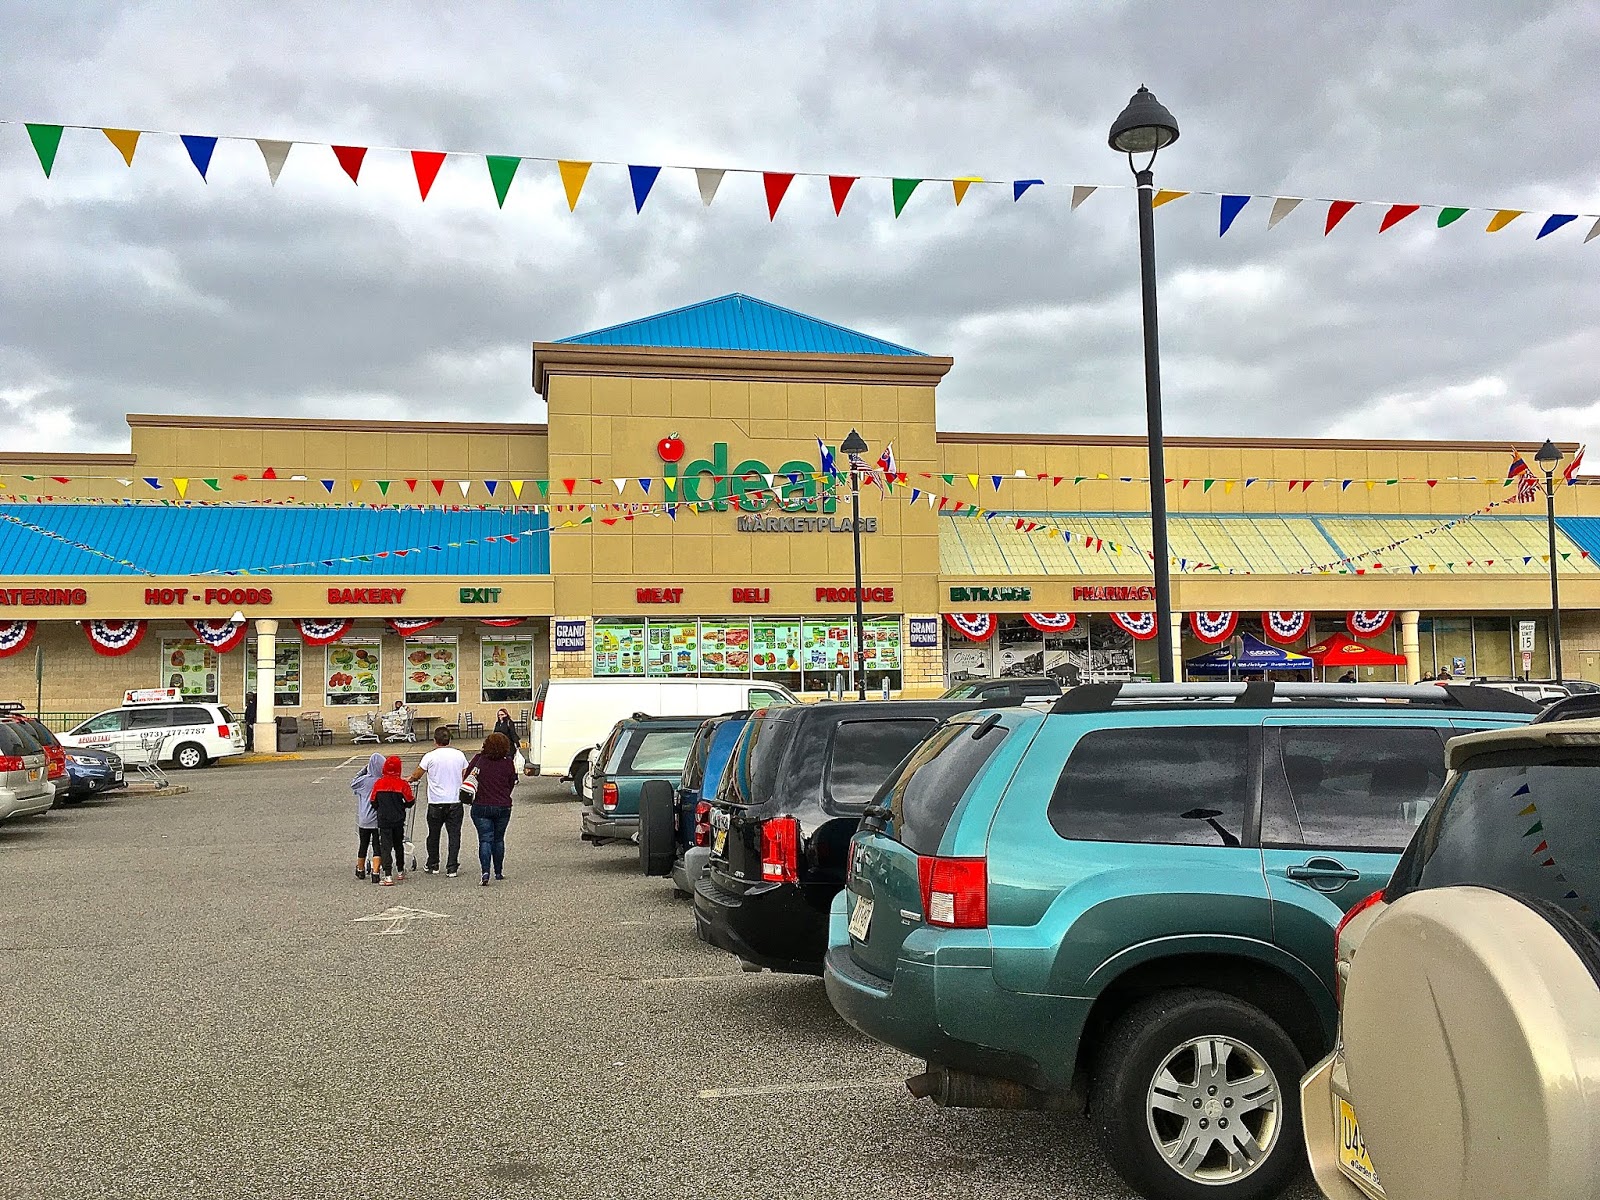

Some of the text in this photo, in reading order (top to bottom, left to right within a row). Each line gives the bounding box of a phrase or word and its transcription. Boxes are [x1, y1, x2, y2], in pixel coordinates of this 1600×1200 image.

[657, 434, 837, 514] ideal
[145, 588, 188, 605] HOT
[205, 588, 272, 605] FOODS
[327, 588, 406, 605] BAKERY
[459, 587, 502, 604] EXIT
[636, 587, 684, 604] MEAT
[732, 587, 770, 604] DELI
[815, 587, 894, 602] PRODUCE
[949, 586, 1031, 602] ENTRANCE
[556, 625, 585, 638] GRAND
[910, 621, 937, 634] GRAND
[556, 637, 585, 647] OPENING
[910, 633, 937, 643] OPENING
[1522, 637, 1532, 648] 15
[140, 731, 163, 739] (973)
